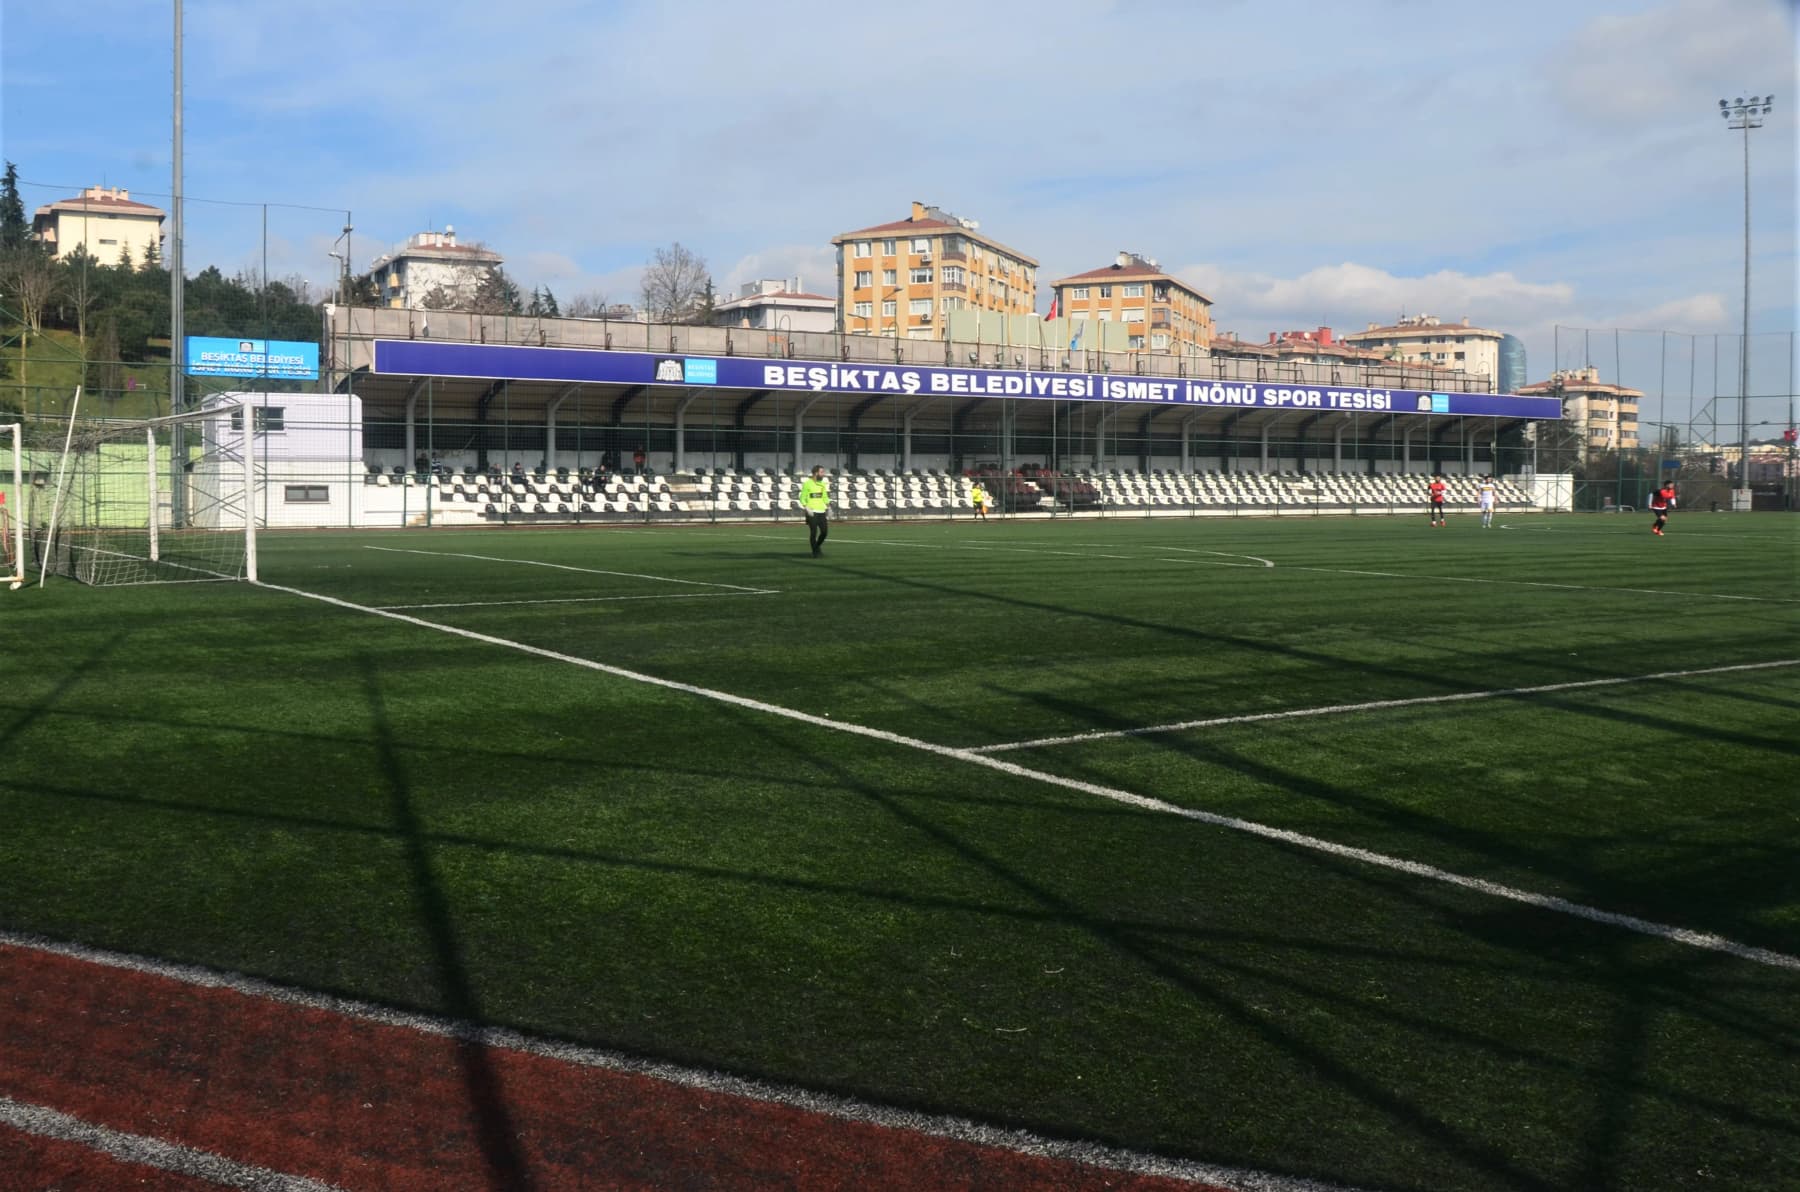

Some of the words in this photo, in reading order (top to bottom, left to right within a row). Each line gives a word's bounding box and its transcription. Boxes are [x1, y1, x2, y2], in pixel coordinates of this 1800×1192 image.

[763, 365, 921, 394] BEŞİKTAŞ
[930, 372, 1094, 397] BELEDİYESİ
[1102, 376, 1178, 400] İSMET
[1185, 381, 1257, 405] İNÖNÜ
[1263, 387, 1322, 407] SPOR
[1326, 389, 1392, 410] TESİSİ
